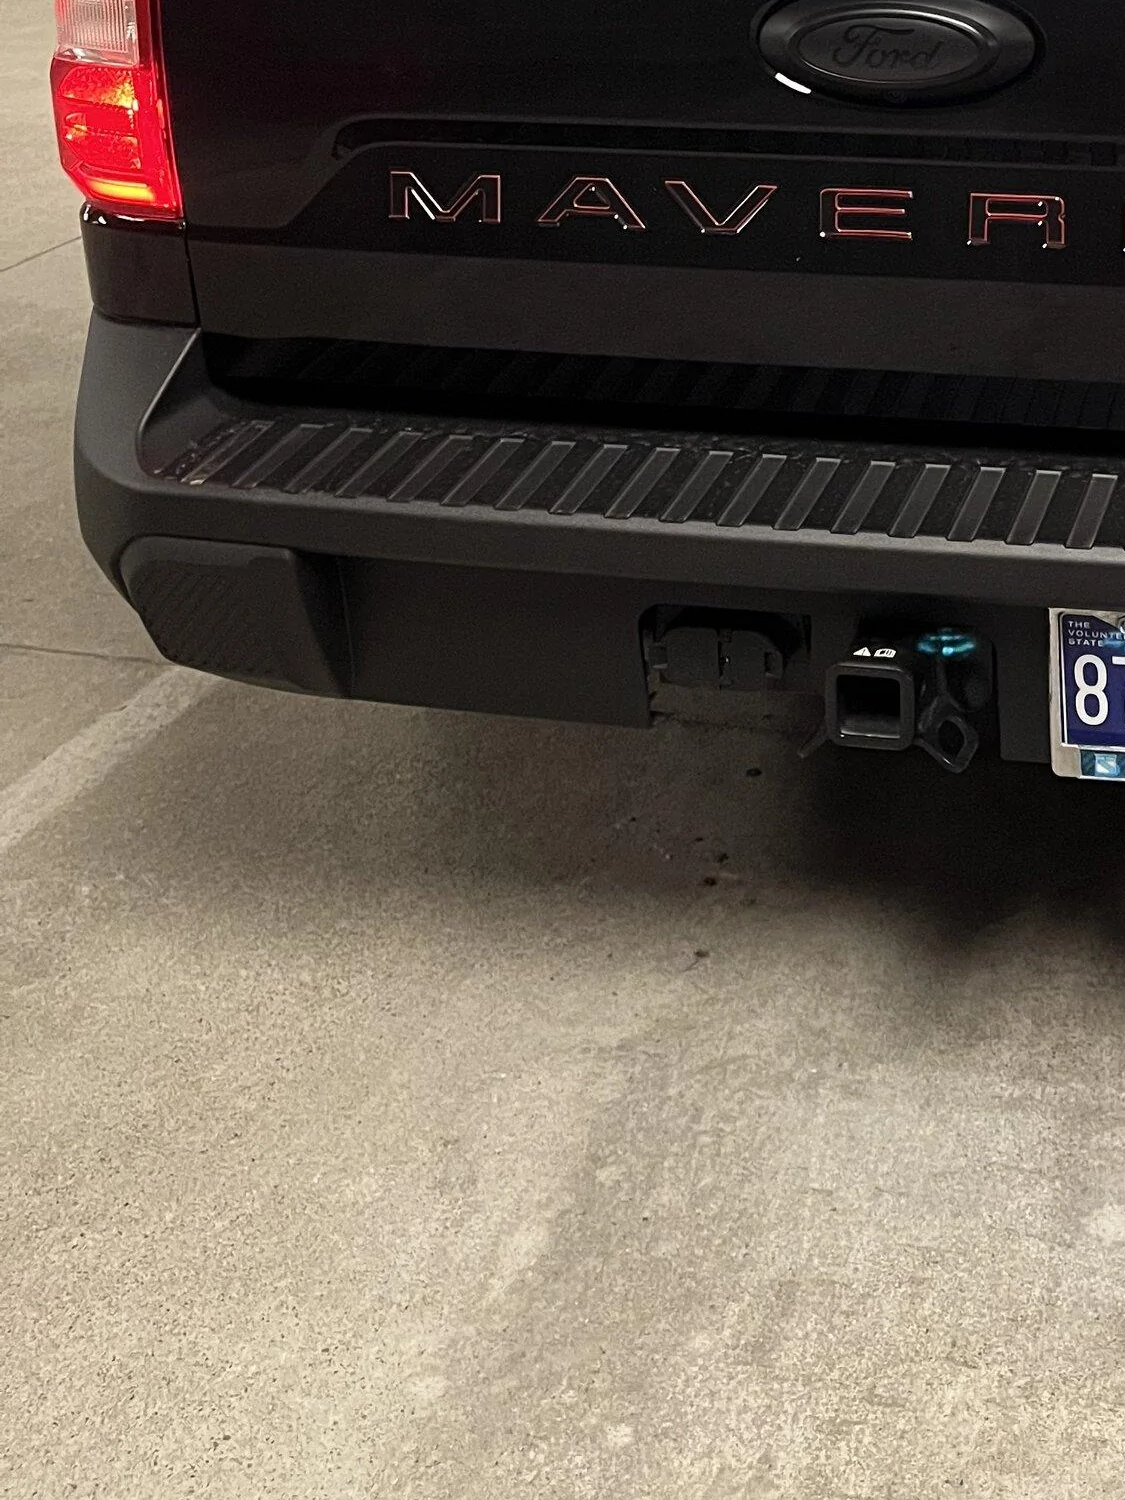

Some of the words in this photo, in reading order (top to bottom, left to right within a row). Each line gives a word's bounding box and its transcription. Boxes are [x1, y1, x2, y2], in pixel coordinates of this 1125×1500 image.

[831, 23, 944, 70] Ford
[1067, 620, 1090, 629] THE
[1067, 638, 1104, 648] STATE
